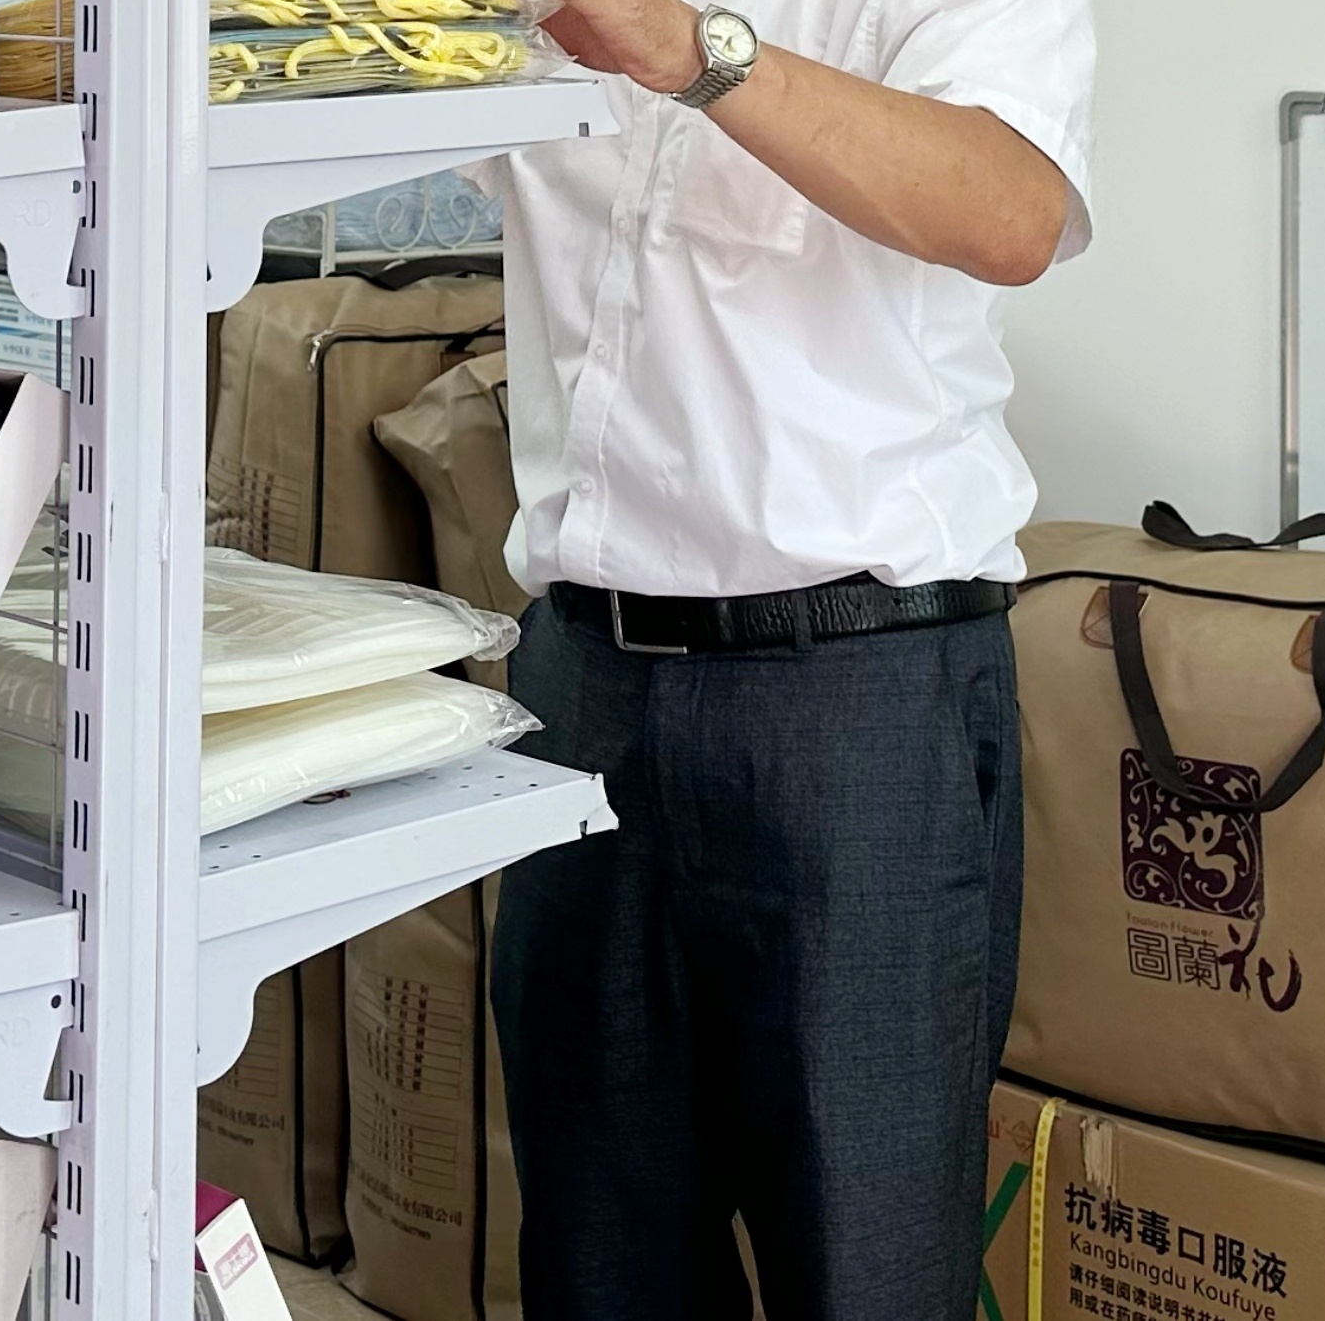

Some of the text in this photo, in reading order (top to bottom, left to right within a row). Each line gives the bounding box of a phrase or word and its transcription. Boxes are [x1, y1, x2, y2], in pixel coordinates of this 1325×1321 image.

[1064, 1182, 1288, 1299] 抗病毒口服液
[1069, 1231, 1276, 1321] Kangbingdu Koufuye
[1069, 1286, 1158, 1321] 用或在药师
